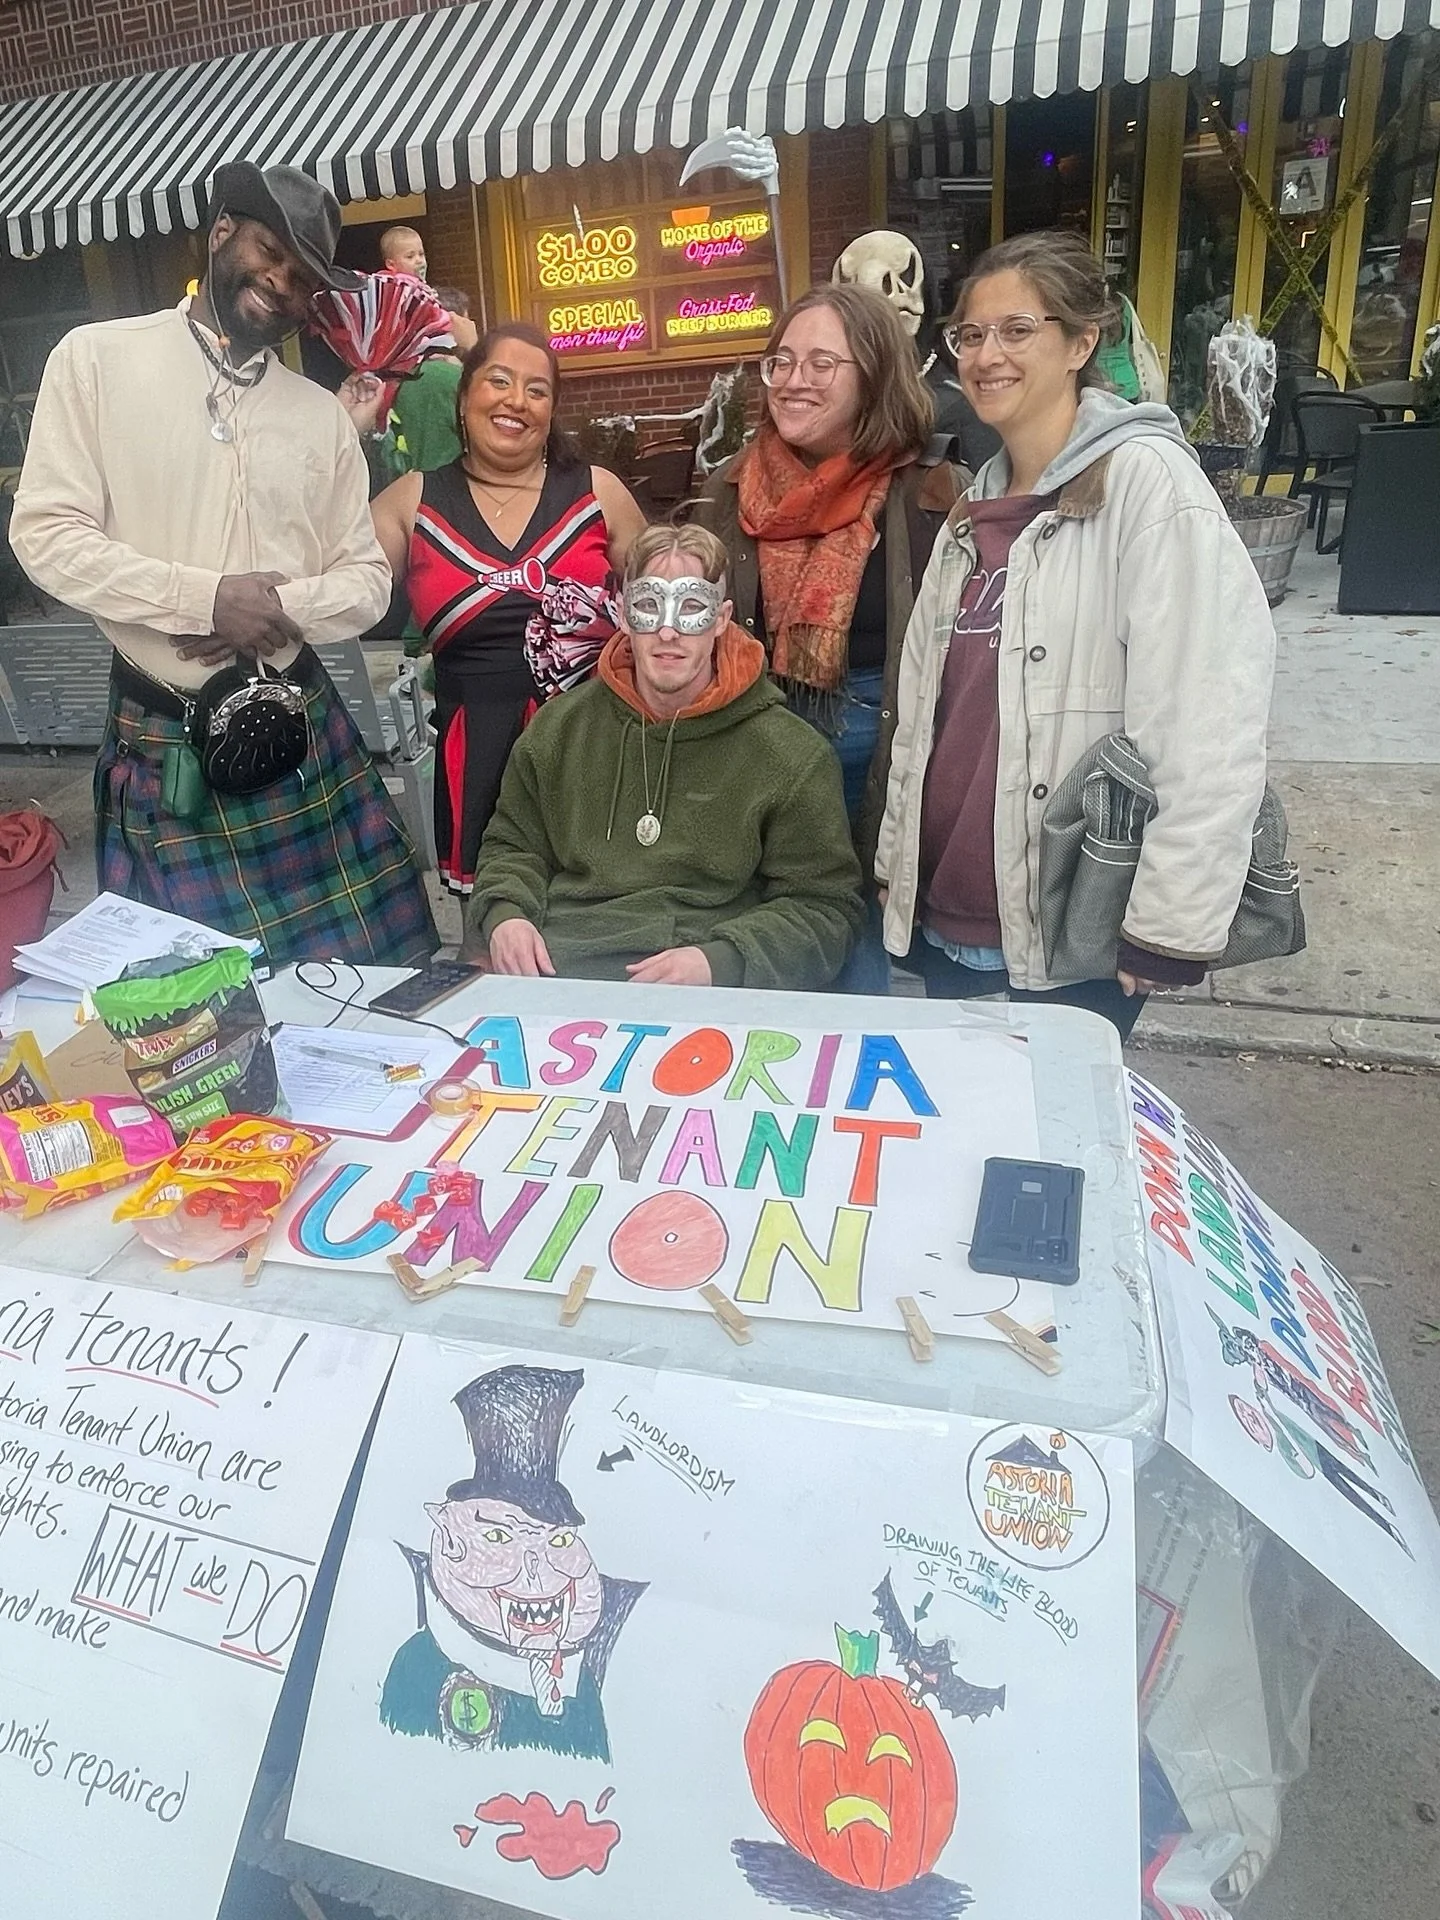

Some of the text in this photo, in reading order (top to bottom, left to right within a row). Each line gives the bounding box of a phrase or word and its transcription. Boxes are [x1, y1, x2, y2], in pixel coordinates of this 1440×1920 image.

[537, 225, 637, 266] $1.00
[661, 213, 768, 248] HOME OF THE
[685, 238, 745, 265] Organic
[540, 256, 637, 287] COMBO
[549, 299, 643, 333] SPECIAL
[667, 308, 772, 338] BEEF BURGER
[679, 292, 755, 318] Grass-Fed
[550, 332, 584, 350] mon
[586, 327, 620, 347] thru
[174, 1041, 215, 1071] SNICKERS
[195, 1060, 240, 1093] GREEN
[466, 1014, 941, 1118] ASTORIA
[185, 1109, 203, 1124] FUN
[201, 1099, 221, 1116] SIZE
[424, 1093, 922, 1206] TENANT
[1134, 1122, 1196, 1267] DOWN
[287, 1165, 872, 1313] UNION
[1236, 1211, 1321, 1380] DOWN
[65, 1291, 248, 1394] tenants
[60, 1383, 138, 1447] Tenant
[138, 1410, 213, 1480] Union
[221, 1450, 282, 1491] are
[612, 1394, 735, 1496] LANDLORDISM
[46, 1450, 73, 1484] to
[79, 1462, 170, 1508] enforce
[178, 1494, 232, 1521] our
[986, 1462, 1074, 1507] ASTORIA
[984, 1485, 1088, 1530] TENANT
[985, 1509, 1074, 1553] UNION
[80, 1518, 307, 1657] WHAT we DO
[883, 1524, 1079, 1639] DRAWING THE LIFE BLOOD
[918, 1561, 1008, 1615] OF TENANTS
[35, 1606, 111, 1649] make
[64, 1750, 190, 1822] repaired
